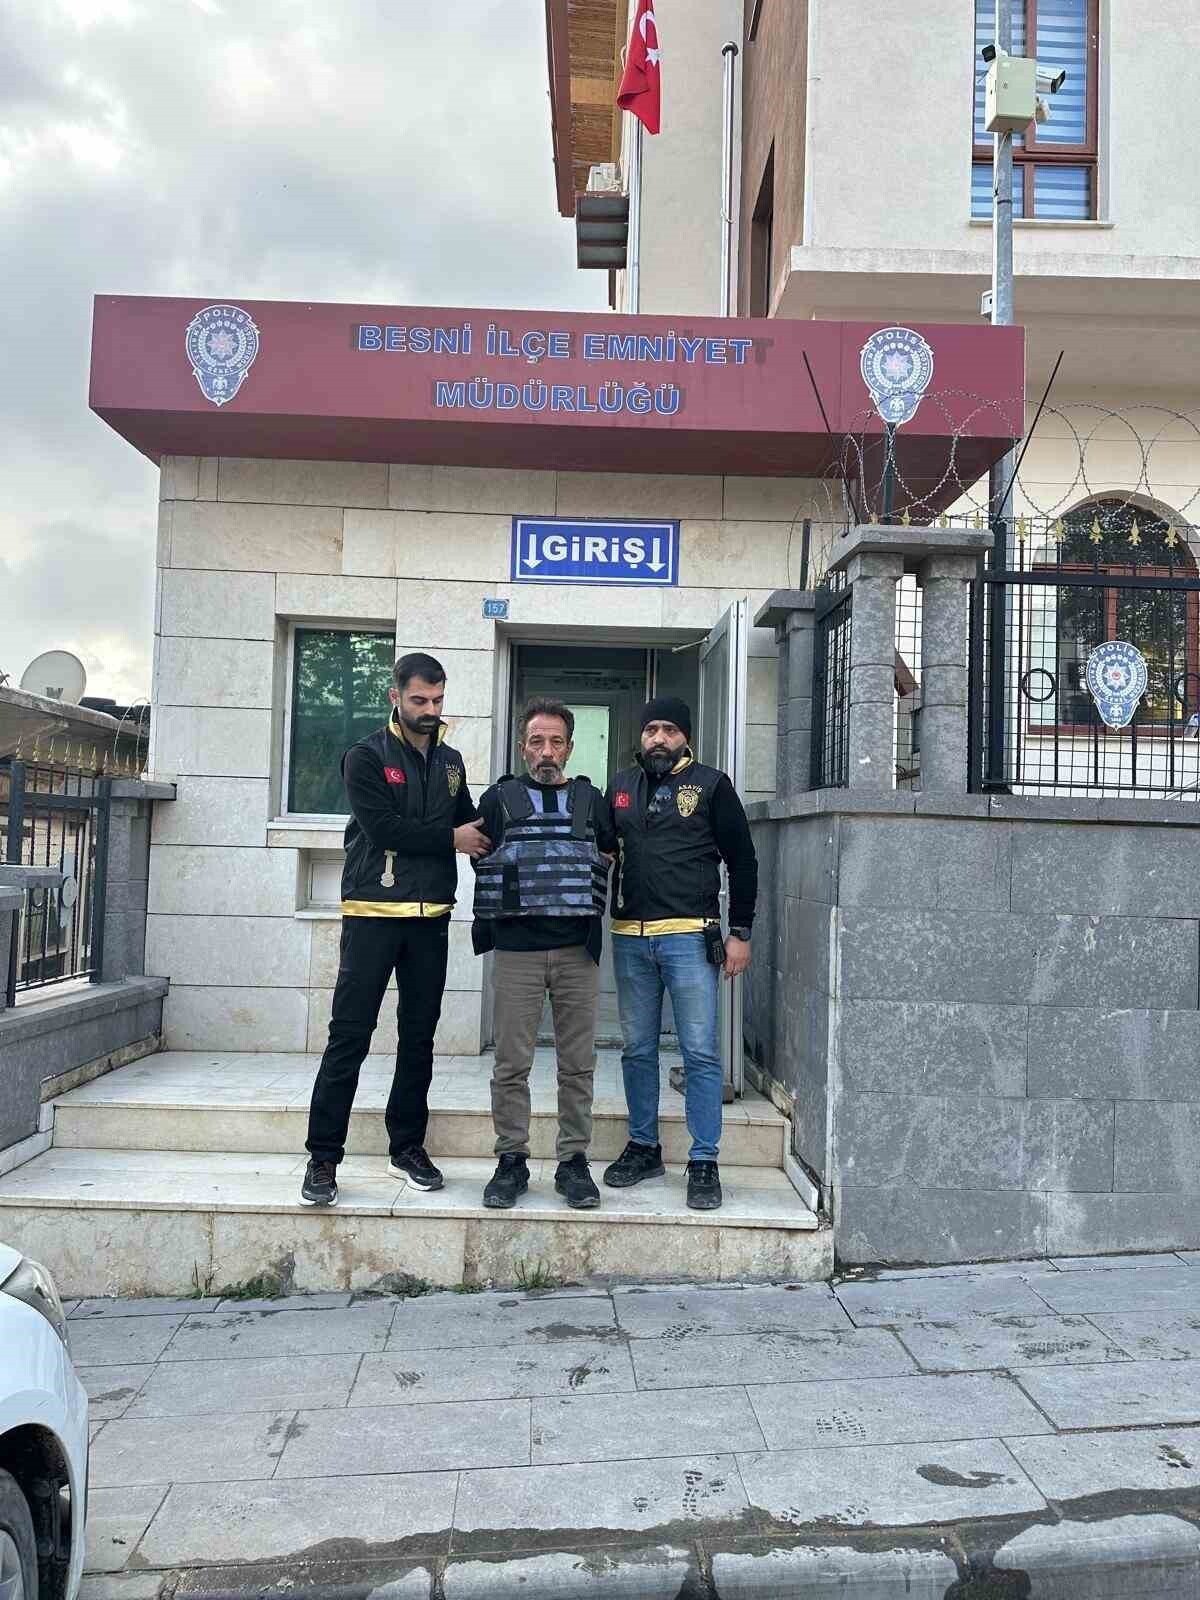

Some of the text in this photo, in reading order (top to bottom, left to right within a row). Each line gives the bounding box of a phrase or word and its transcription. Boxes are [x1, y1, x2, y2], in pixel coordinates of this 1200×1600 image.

[358, 322, 753, 365] BESNİ İLÇE EMNİYET
[436, 377, 680, 415] MÜDÜRLÜĞÜ
[486, 602, 505, 614] 157
